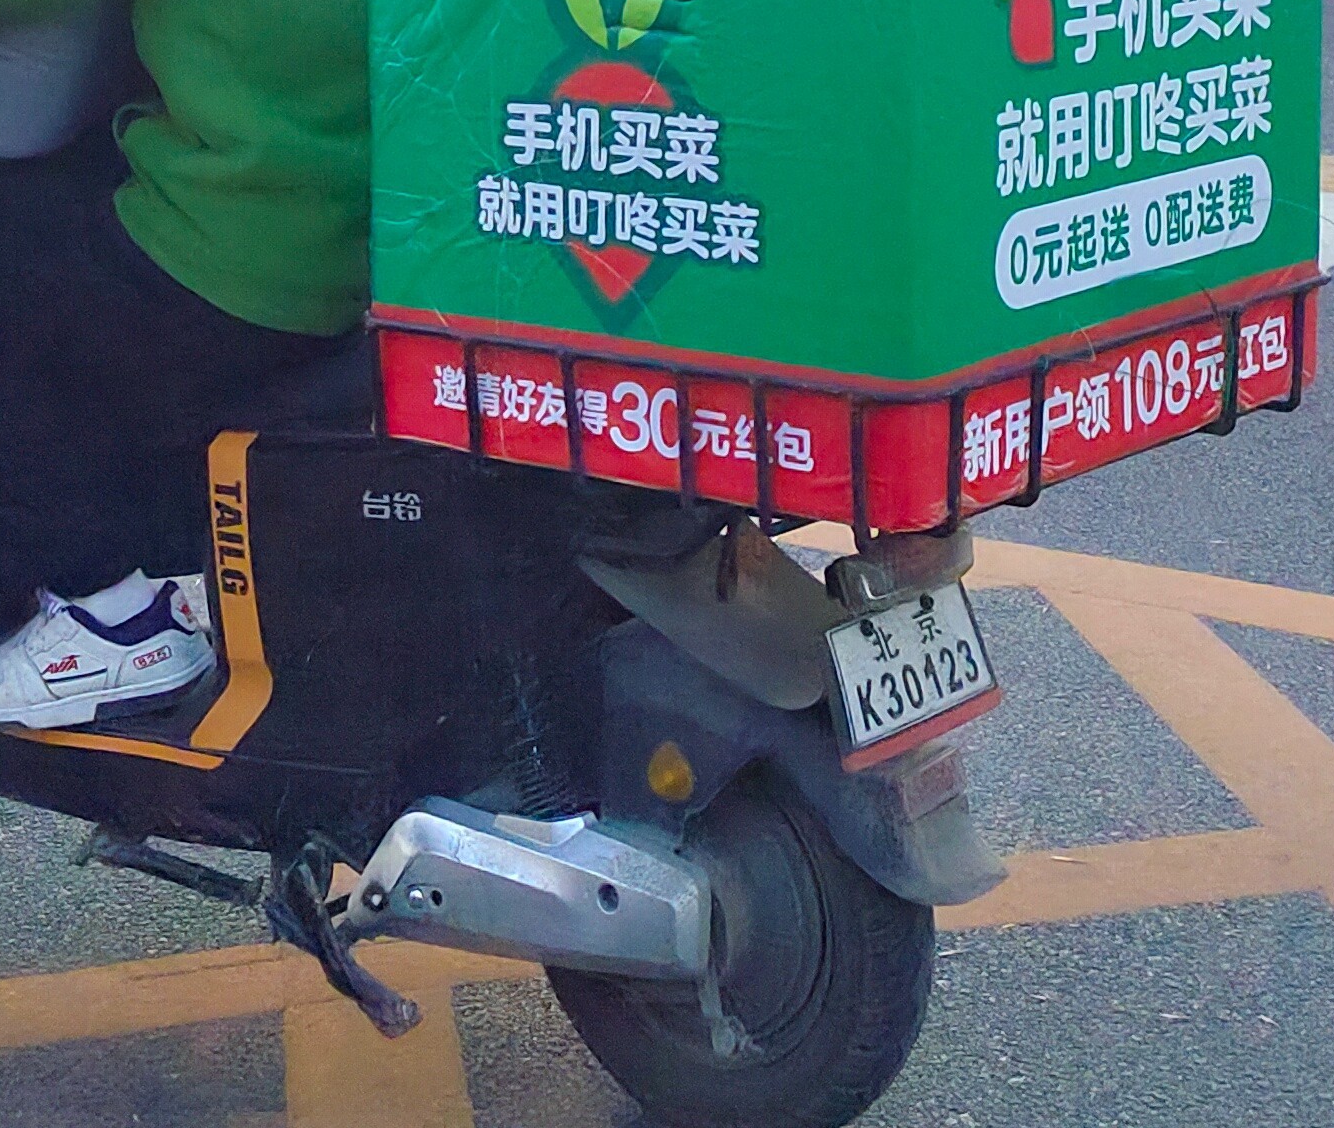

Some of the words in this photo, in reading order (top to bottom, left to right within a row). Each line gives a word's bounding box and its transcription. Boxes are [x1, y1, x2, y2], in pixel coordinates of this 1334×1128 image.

[503, 102, 720, 184] 手机买菜
[996, 54, 1273, 197] 就用叮咚买菜
[477, 175, 760, 264] 就用叮咚买菜
[1010, 203, 1131, 285] 0元起送
[1145, 172, 1255, 247] 0配送费
[214, 479, 250, 597] TAILG
[363, 489, 422, 522] 台铃
[42, 654, 81, 675] AVIA
[872, 609, 943, 663] 北京
[856, 639, 980, 732] K30123
